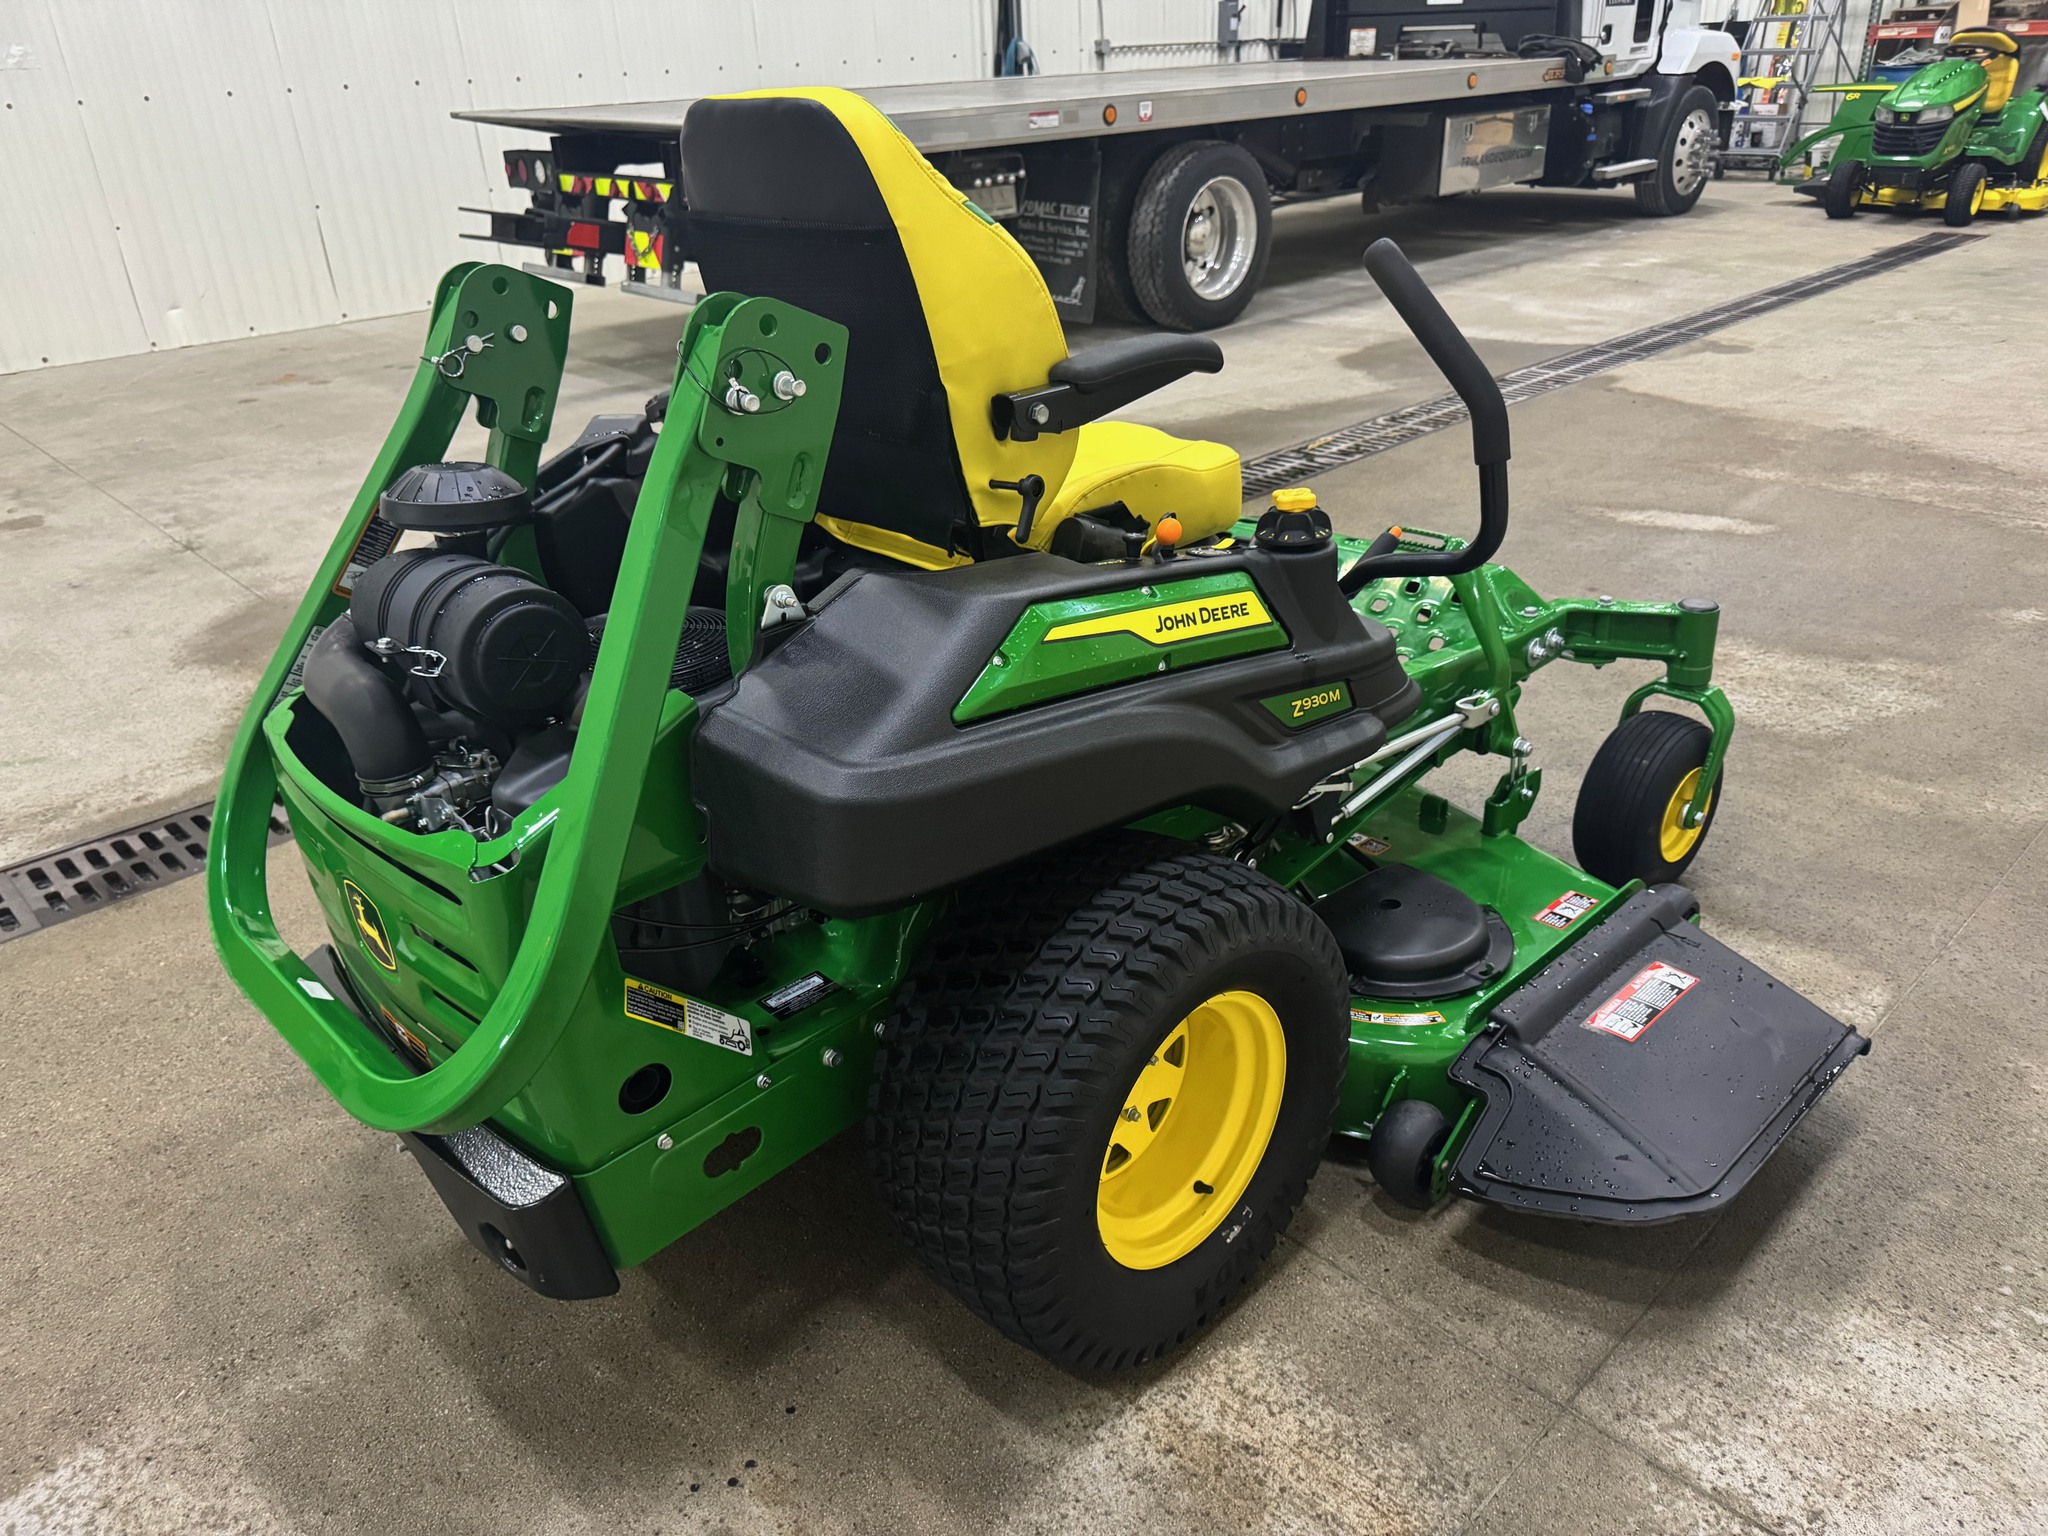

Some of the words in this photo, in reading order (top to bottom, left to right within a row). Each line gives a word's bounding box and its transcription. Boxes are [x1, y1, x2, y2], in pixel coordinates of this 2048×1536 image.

[1845, 92, 1861, 101] 6R
[1060, 203, 1091, 222] TRUCK
[1075, 225, 1090, 238] Inc.
[1155, 612, 1197, 633] JOHN
[1198, 602, 1250, 624] DEERE
[1291, 688, 1341, 718] Z930M
[644, 985, 673, 1001] CAUTION
